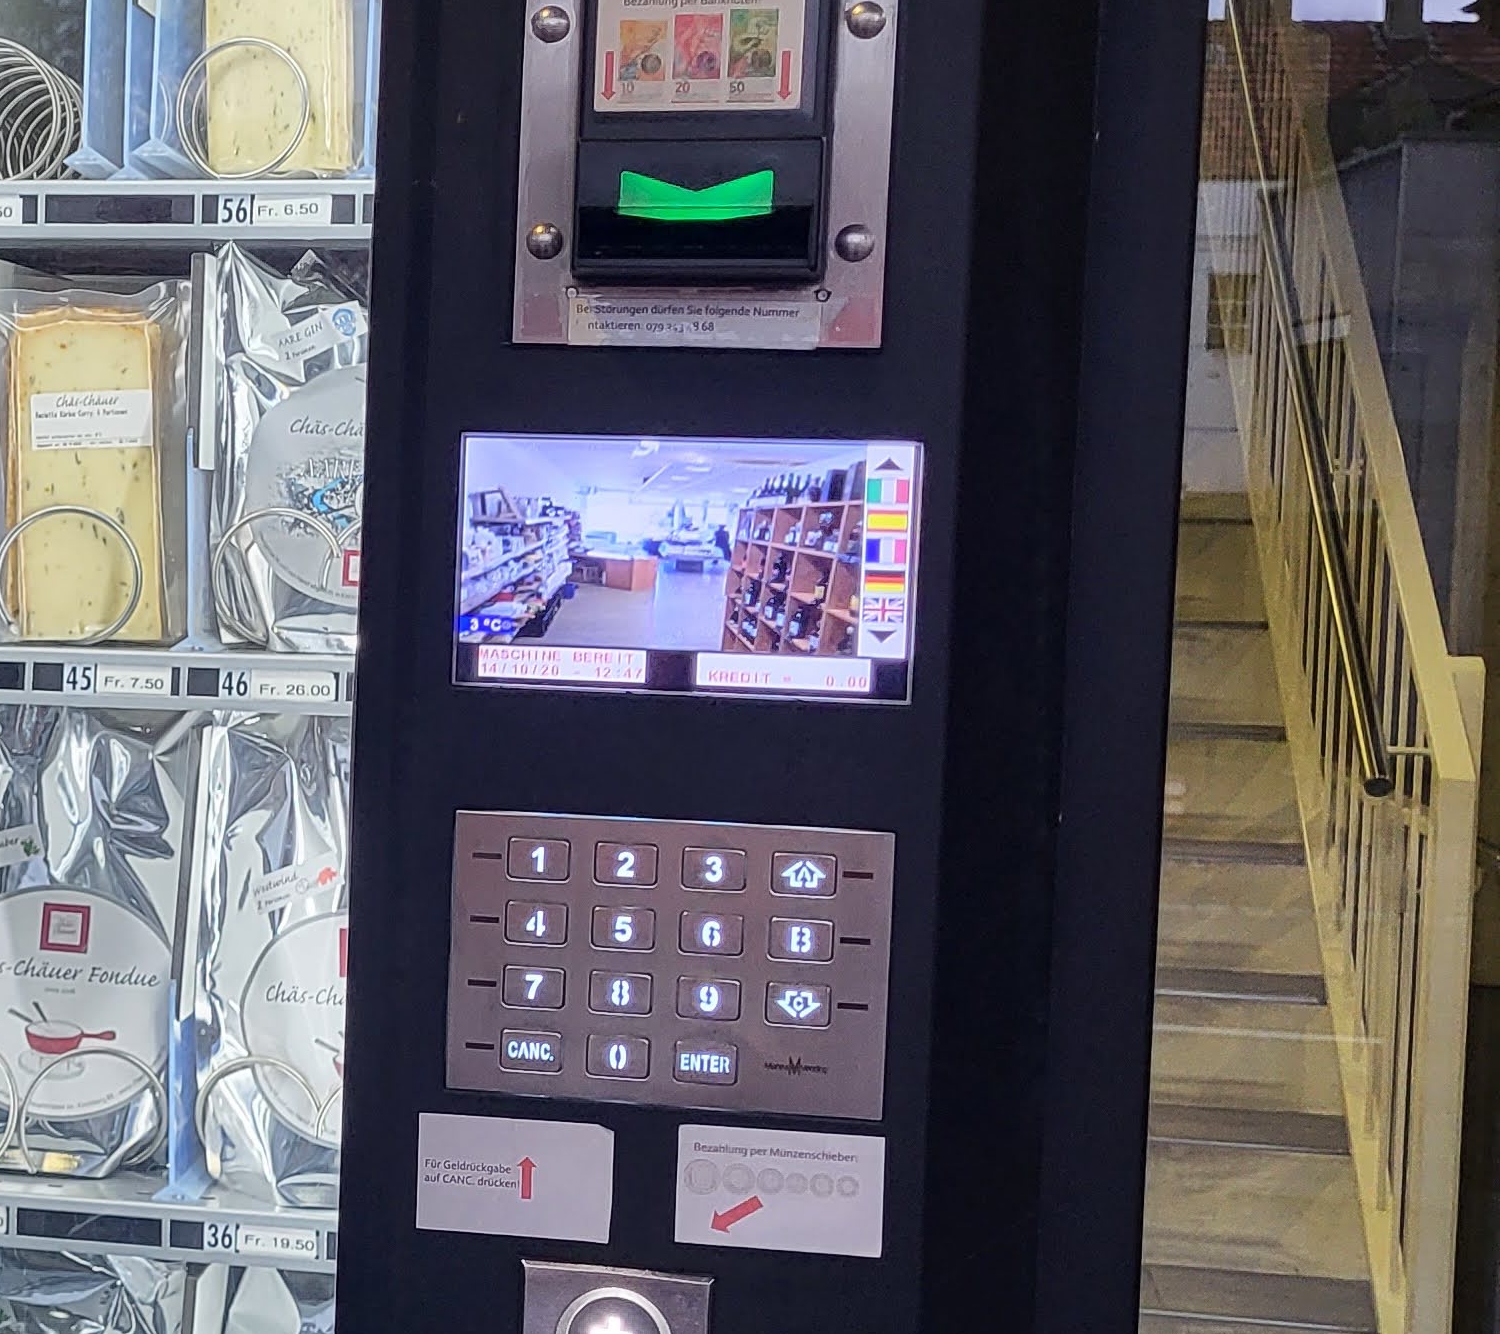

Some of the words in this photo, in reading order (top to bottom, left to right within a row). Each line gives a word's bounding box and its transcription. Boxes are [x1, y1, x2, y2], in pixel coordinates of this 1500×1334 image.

[622, 82, 634, 93] 10
[675, 82, 690, 93] 20
[730, 82, 744, 93] 50
[222, 197, 247, 222] 56
[258, 204, 277, 217] Fr.
[283, 203, 319, 216] 6.50
[595, 305, 648, 316] Störungen
[651, 305, 684, 316] dürfen
[687, 305, 703, 315] Sie
[705, 306, 750, 319] folgende
[753, 307, 799, 318] Nummer
[304, 322, 324, 339] GIN
[480, 649, 560, 662] MASCHINE
[573, 651, 633, 664] BEREIT
[66, 665, 91, 690] 45
[105, 676, 124, 689] Fr.
[130, 677, 163, 690] 7.50
[481, 663, 559, 676] 14/10/20
[595, 667, 643, 679] 12:47
[709, 671, 771, 684] KREDIT
[826, 675, 868, 688] 0.00
[222, 671, 247, 696] 46
[259, 683, 280, 696] Fr.
[286, 683, 330, 697] 26.00
[531, 847, 545, 872] 1
[617, 852, 635, 877] 2
[706, 856, 722, 882] 3
[526, 911, 545, 936] 4
[615, 916, 632, 942] 5
[702, 921, 720, 947] 6
[791, 926, 810, 952] B
[88, 967, 161, 987] Fondue
[526, 975, 543, 999] 7
[611, 980, 629, 1005] 8
[700, 985, 718, 1011] 9
[507, 1041, 554, 1061] CANC.
[609, 1044, 626, 1069] 0
[680, 1053, 729, 1074] ENTER
[694, 1142, 748, 1157] Bezahlung
[750, 1147, 767, 1159] per
[425, 1158, 441, 1170] Für
[444, 1159, 512, 1176] Geldrückgabe
[424, 1173, 441, 1184] auf
[443, 1174, 475, 1186] CANC.
[208, 1223, 233, 1248] 36
[245, 1235, 264, 1247] Fr.
[271, 1236, 314, 1251] 19.50
